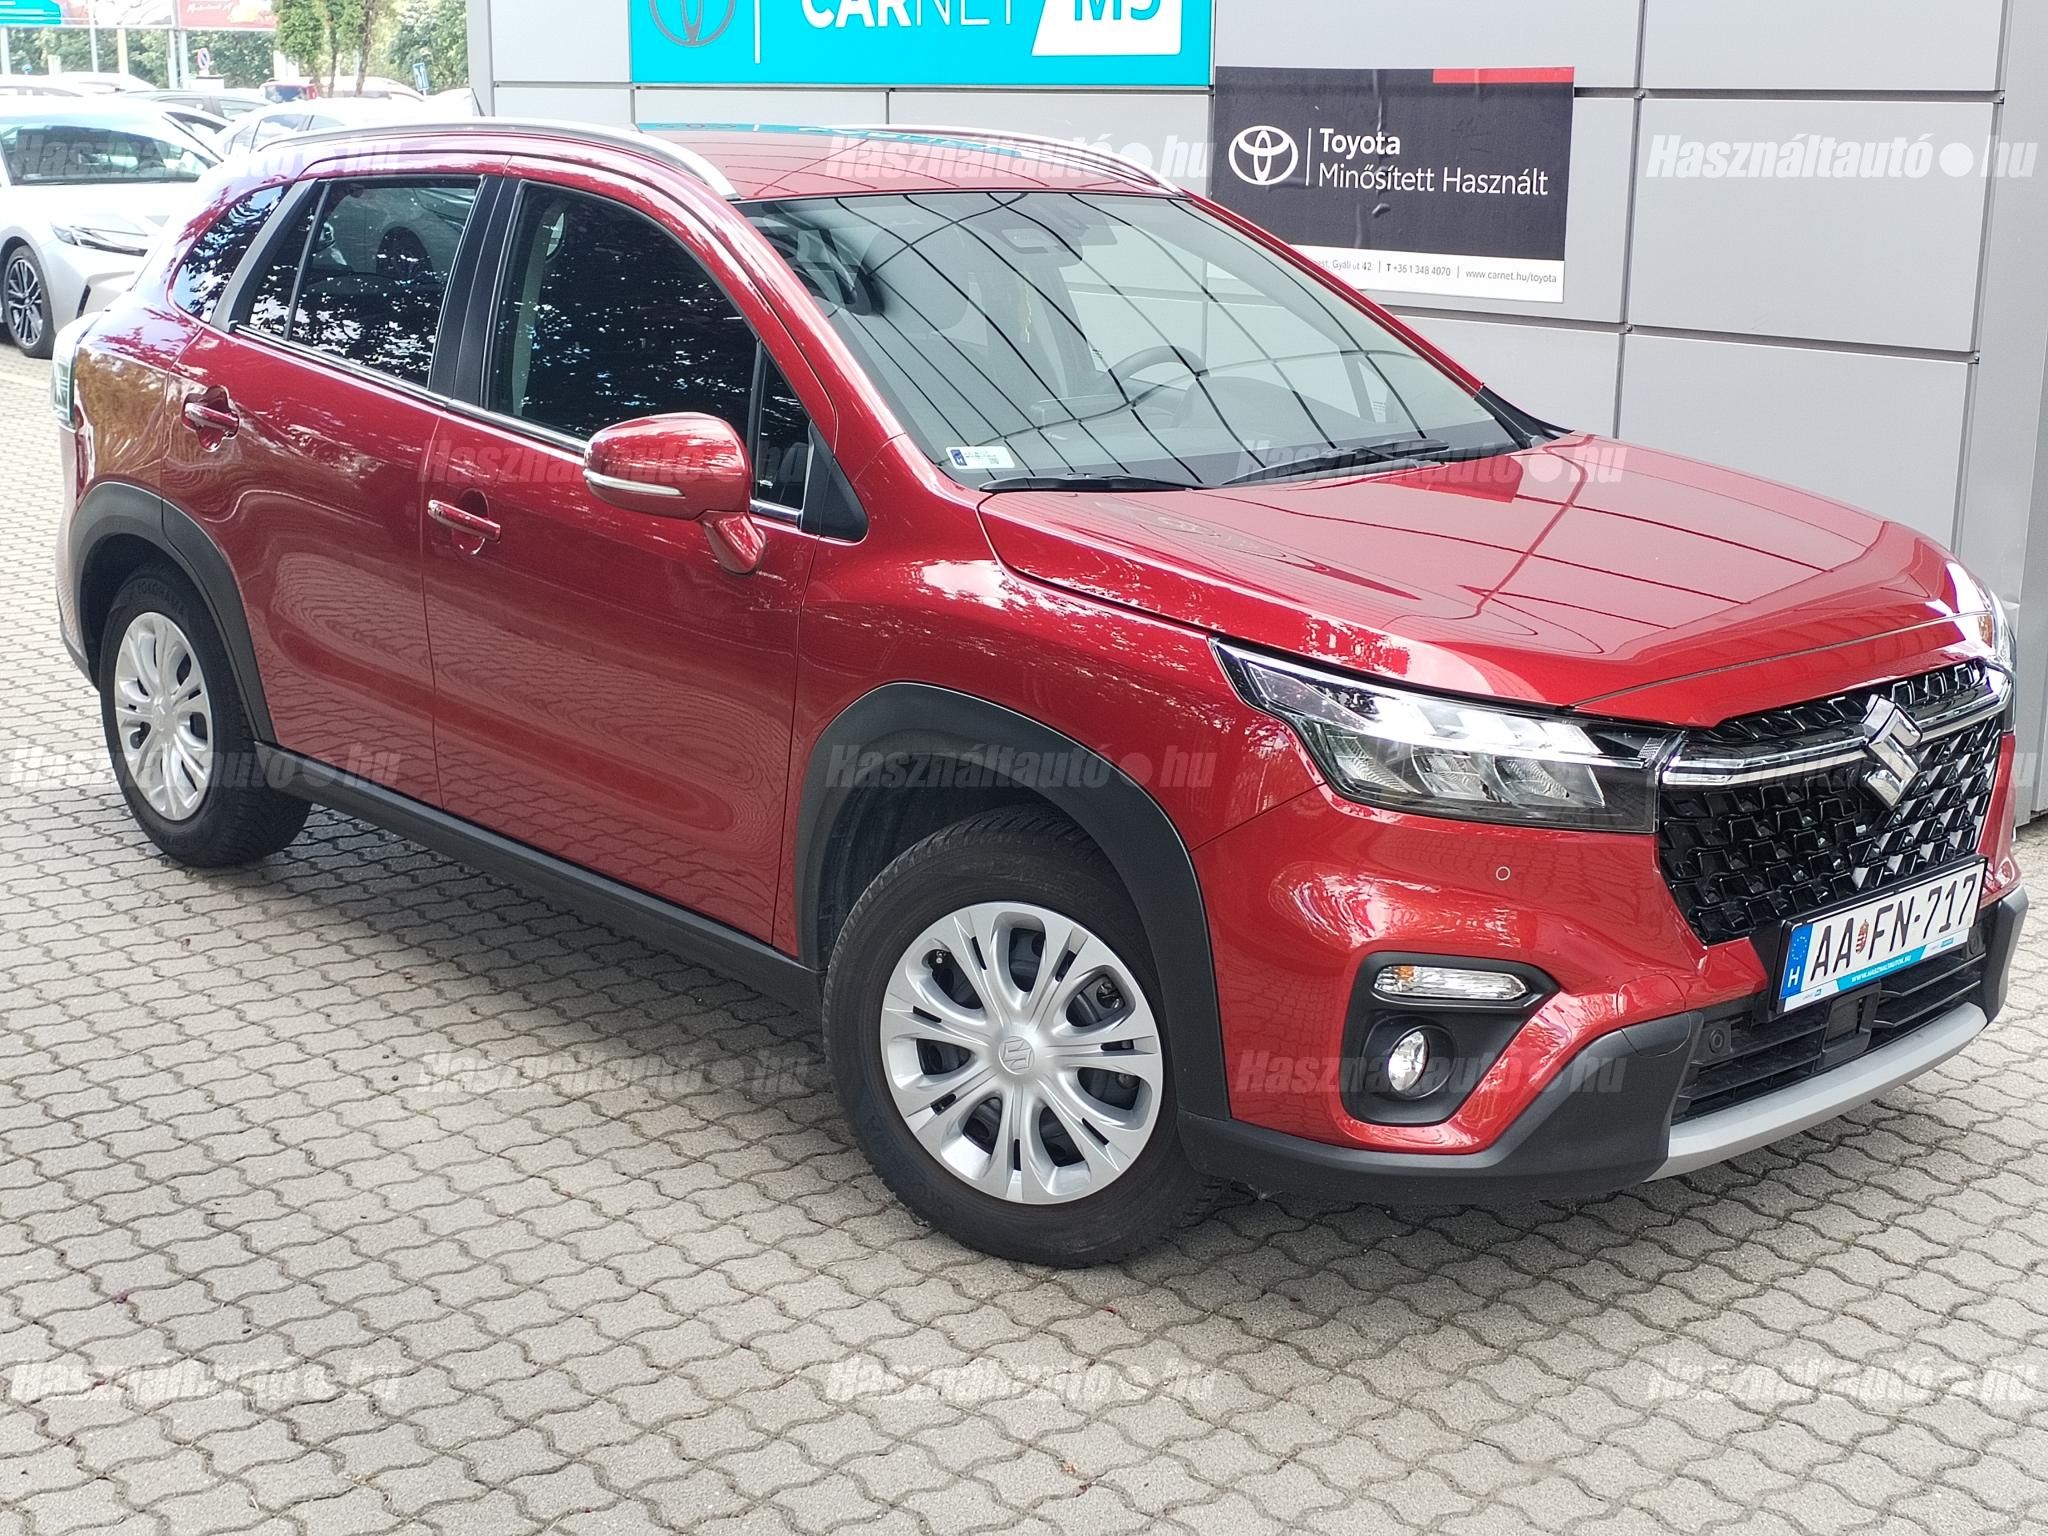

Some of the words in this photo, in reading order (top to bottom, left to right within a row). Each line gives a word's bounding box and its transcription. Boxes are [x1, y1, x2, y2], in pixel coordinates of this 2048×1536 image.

[1319, 128, 1400, 159] Toyota
[1318, 162, 1435, 191] Minősített
[1442, 166, 1549, 195] Használt
[1362, 261, 1372, 271] 42
[1386, 263, 1392, 272] T
[1394, 263, 1408, 273] +36
[1415, 265, 1430, 275] 348
[1432, 266, 1451, 277] 4070
[1466, 270, 1557, 284] www.carnet.hu/toyota
[1810, 917, 1855, 982] AA
[1868, 872, 1977, 960] FN-717
[1787, 966, 1800, 988] H
